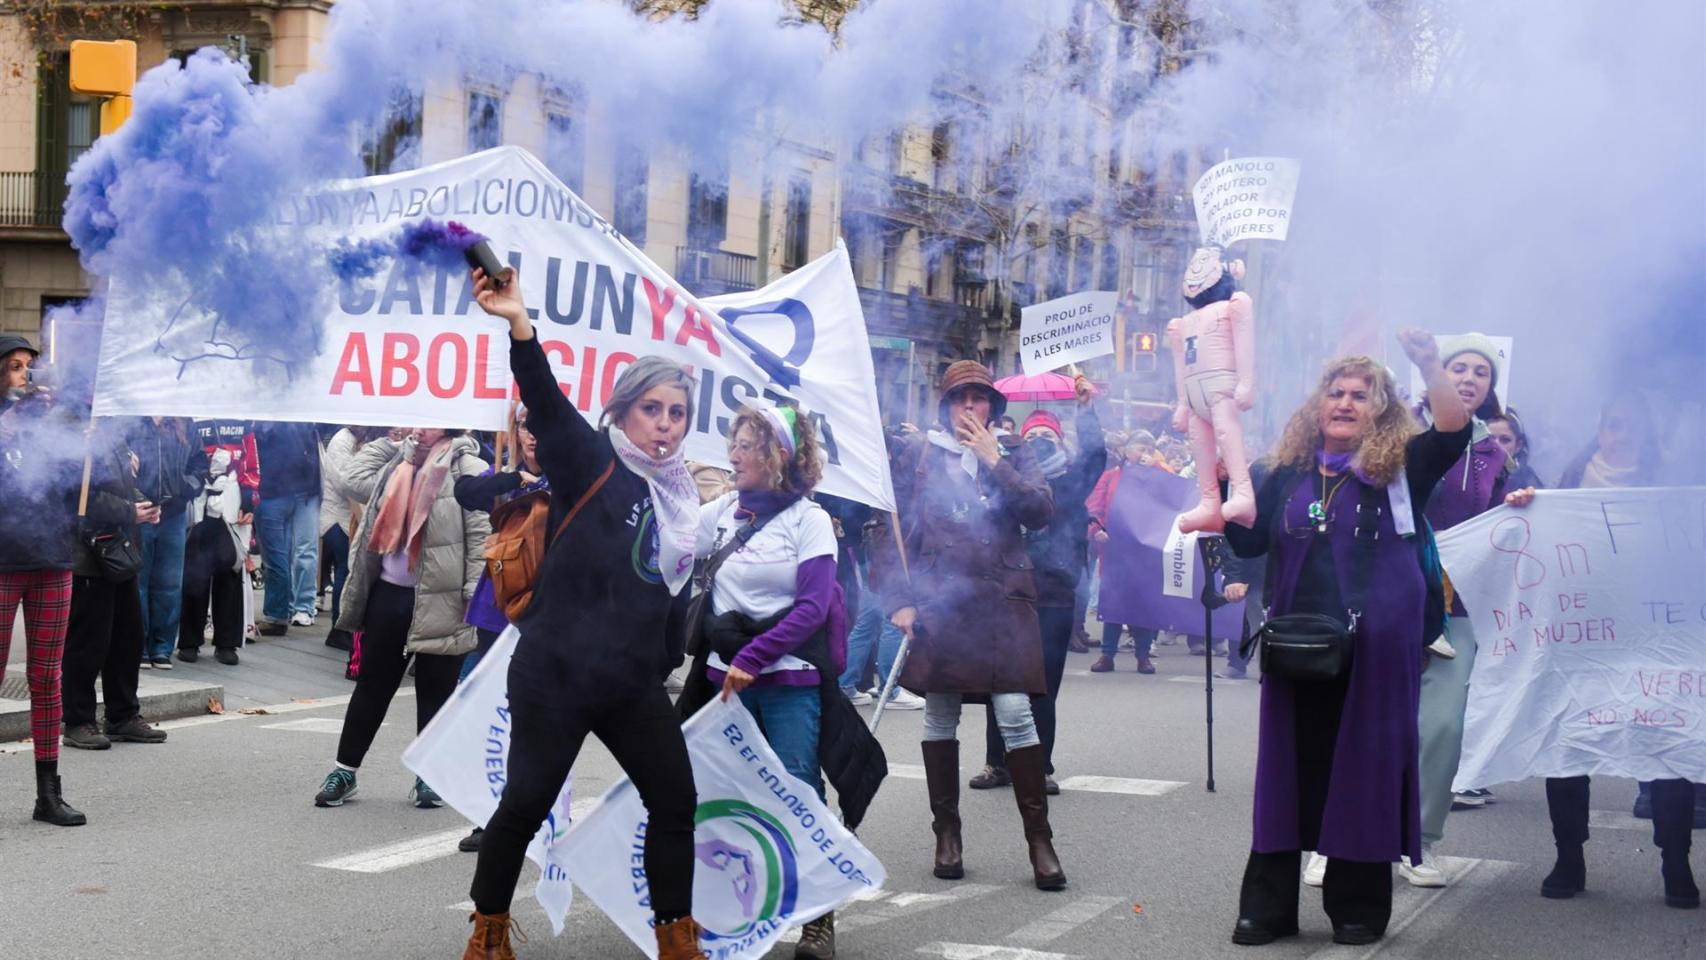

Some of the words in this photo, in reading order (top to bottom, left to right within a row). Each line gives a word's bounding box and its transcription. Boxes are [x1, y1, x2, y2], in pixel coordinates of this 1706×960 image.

[1215, 161, 1275, 180] MANOLO
[1216, 177, 1268, 193] PUTERO
[1219, 208, 1253, 227] PAGO
[1257, 207, 1287, 219] POR
[1221, 223, 1274, 243] MUJERES
[1045, 308, 1076, 325] PROU
[1080, 303, 1093, 315] DE
[1034, 349, 1042, 360] A
[1044, 343, 1061, 356] LES
[1065, 331, 1102, 350] MARES
[1558, 593, 1588, 612] DE
[1641, 602, 1686, 624] TE
[1492, 637, 1517, 656] LA
[1534, 617, 1616, 647] MUJER
[1587, 710, 1617, 726] NO
[1633, 707, 1686, 728] NOS
